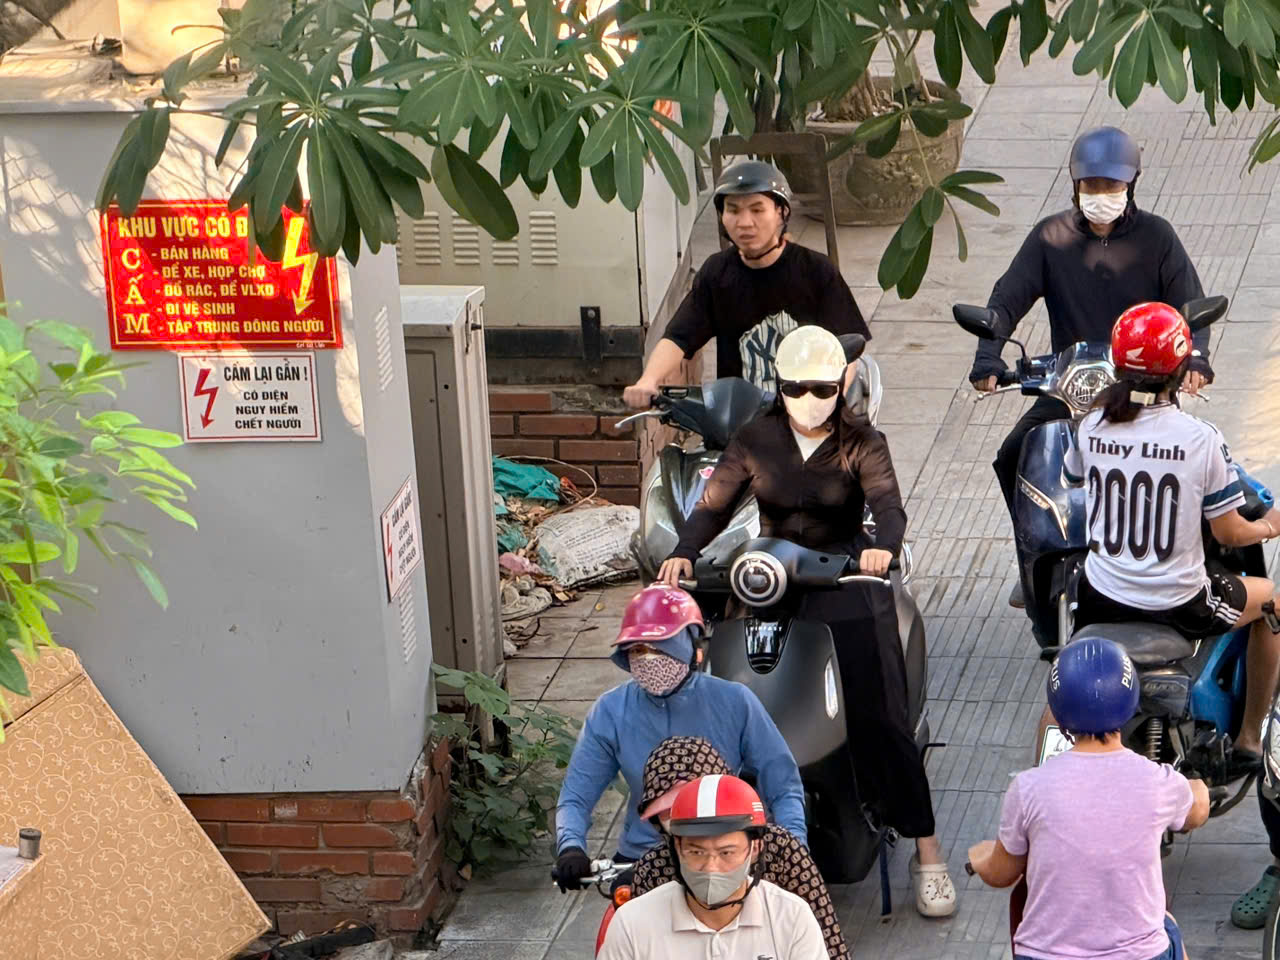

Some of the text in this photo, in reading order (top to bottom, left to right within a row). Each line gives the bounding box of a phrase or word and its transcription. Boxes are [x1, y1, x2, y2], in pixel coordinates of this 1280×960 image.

[118, 216, 156, 238] KHU
[161, 214, 199, 242] VỰC
[205, 212, 231, 238] CÓ
[160, 244, 189, 260] BÁN
[192, 244, 229, 260] HÀNG
[183, 265, 205, 279] XE,
[207, 265, 235, 280] HỌP
[185, 281, 217, 298] RÁC,
[165, 302, 180, 315] ĐI
[183, 300, 199, 318] VỆ
[203, 302, 236, 315] SINH
[195, 320, 240, 334] TRUNG
[243, 318, 281, 333] ĐÔNG
[283, 317, 325, 333] NGƯỜI
[223, 360, 251, 381] CẤM
[254, 366, 273, 385] LẠI
[275, 358, 301, 381] GẦN
[243, 389, 289, 402] CÓ ĐIỆN
[235, 402, 299, 415] NGUY HIỂM
[234, 416, 302, 429] CHẾT NGƯỜI
[1088, 436, 1186, 462] Thùy Linh
[1088, 465, 1181, 562] 2000
